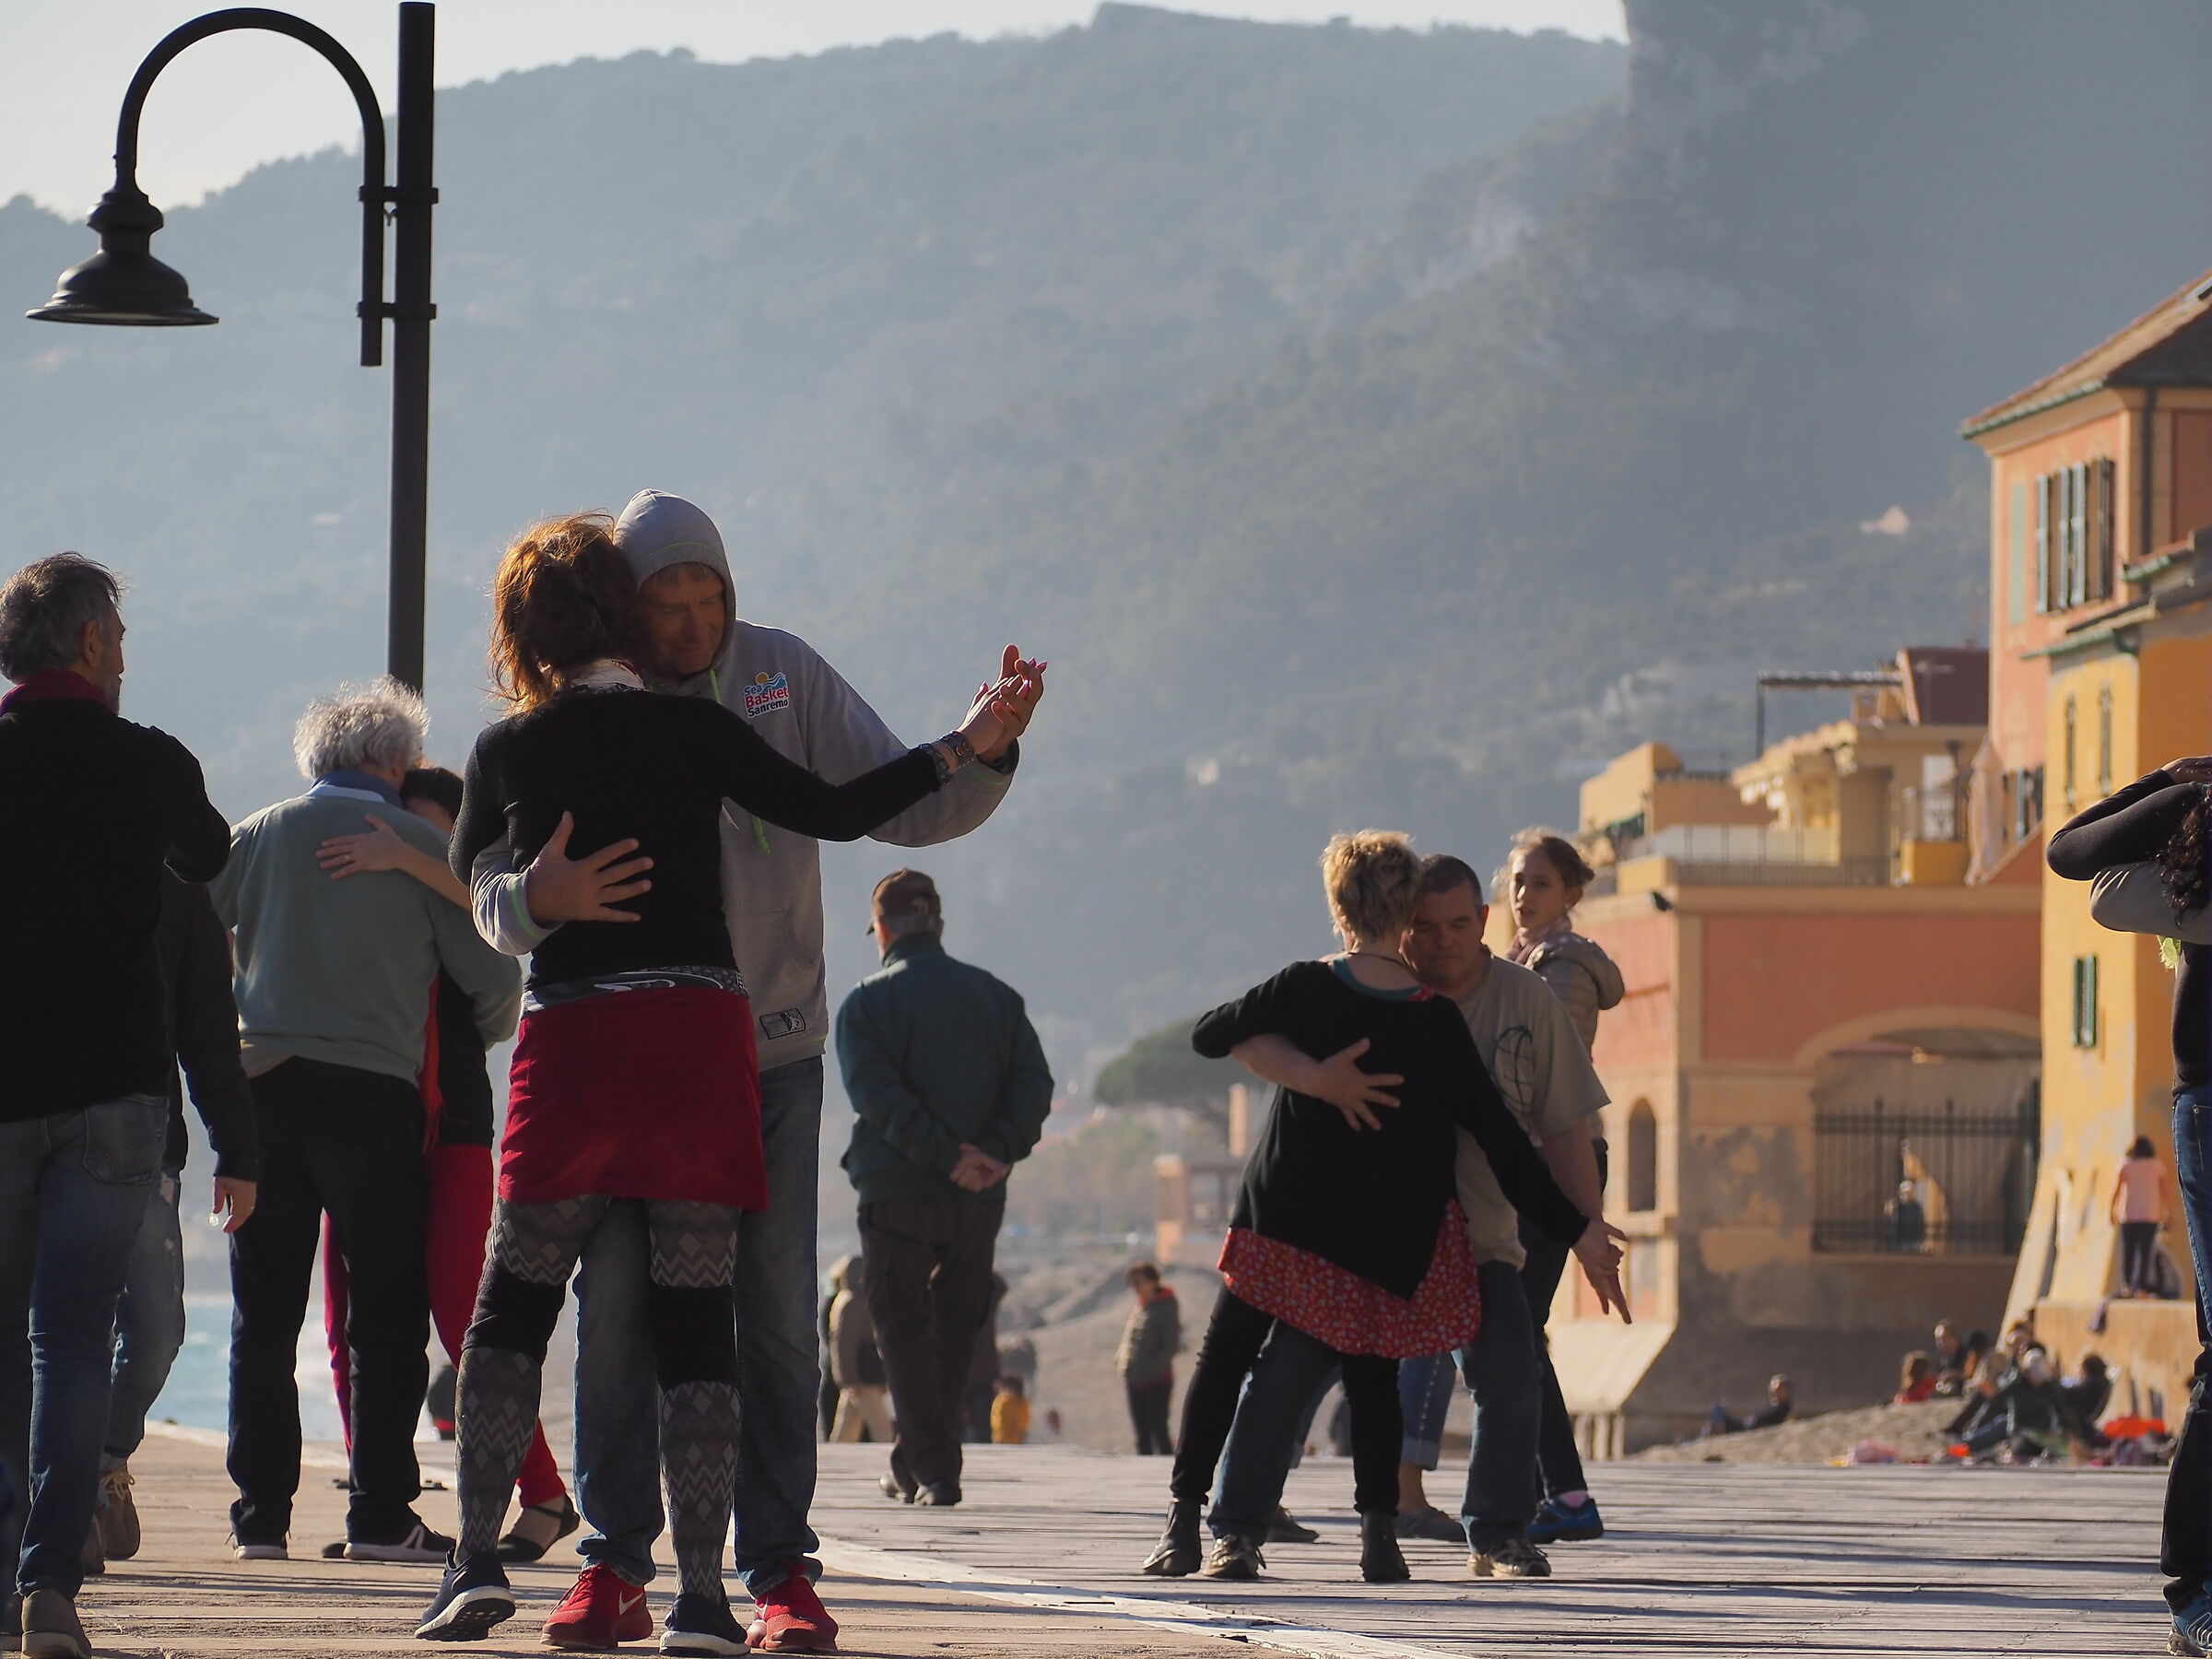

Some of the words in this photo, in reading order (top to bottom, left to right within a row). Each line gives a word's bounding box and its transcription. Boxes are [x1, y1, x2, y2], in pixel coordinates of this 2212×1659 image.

[744, 685, 763, 697] Sea
[746, 687, 789, 709] Basket
[747, 699, 789, 717] Sanremo
